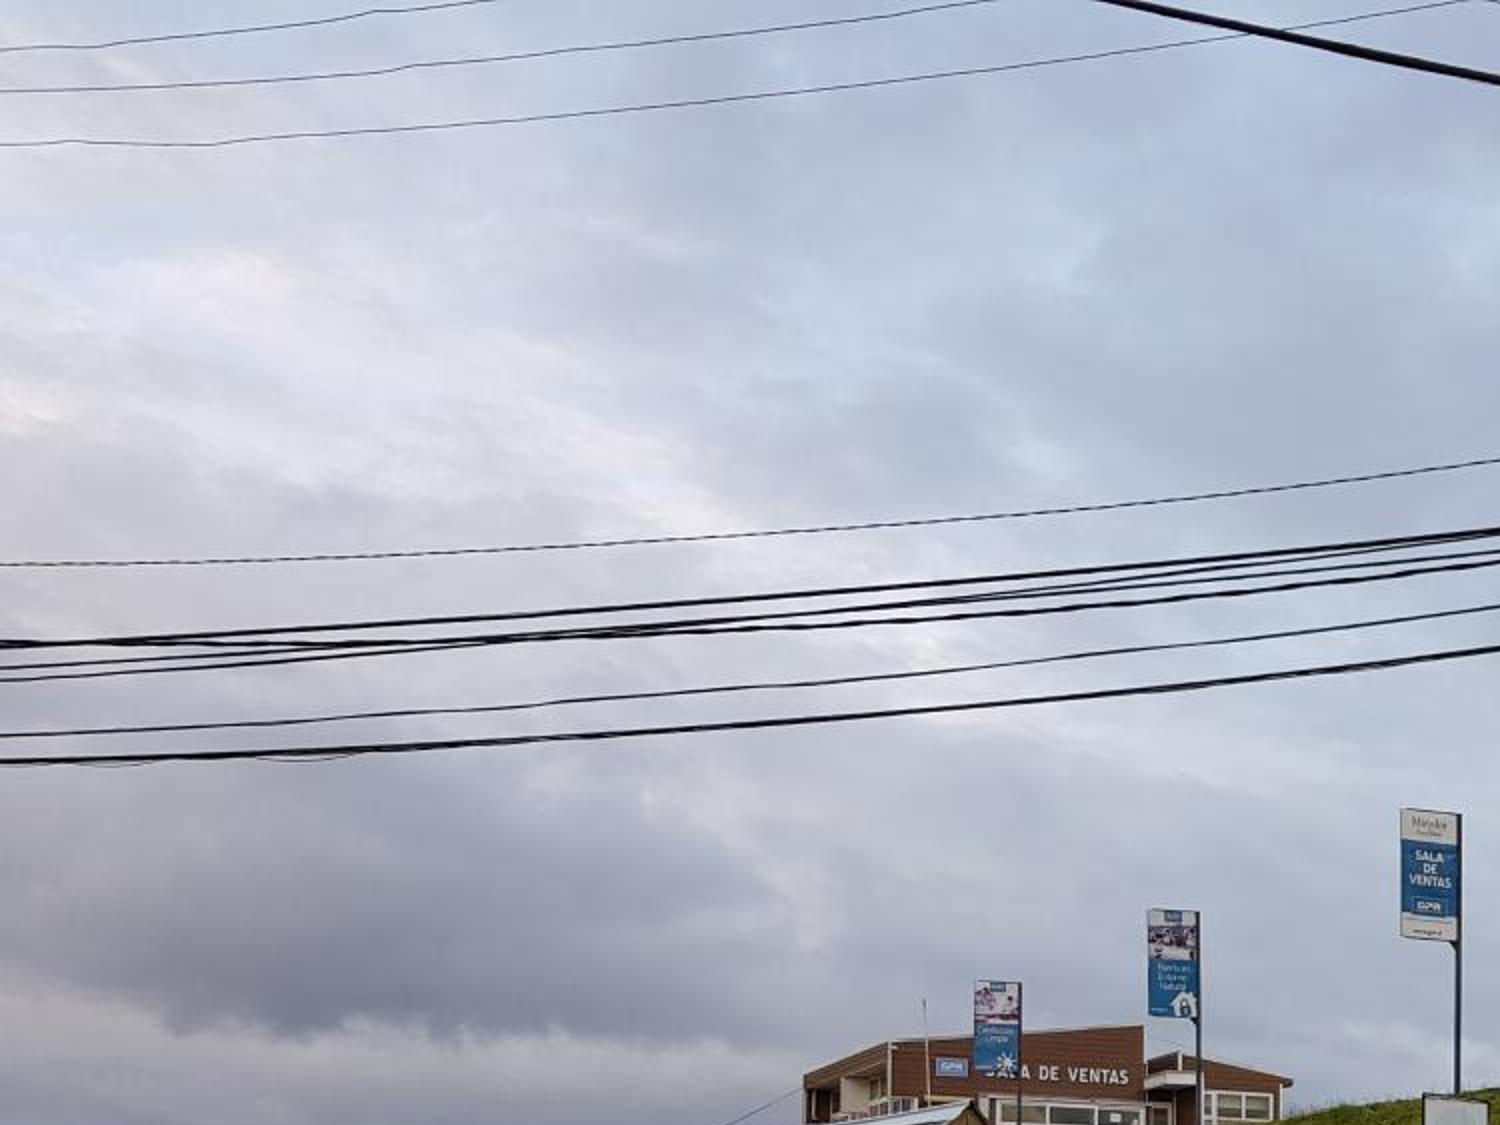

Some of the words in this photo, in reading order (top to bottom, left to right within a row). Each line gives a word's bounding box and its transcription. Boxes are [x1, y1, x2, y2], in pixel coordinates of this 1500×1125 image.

[1415, 850, 1444, 863] SALA
[1423, 863, 1439, 875] DE
[1409, 874, 1452, 889] VENTAS
[1039, 1065, 1060, 1081] DE
[1068, 1067, 1129, 1085] VENTAS
